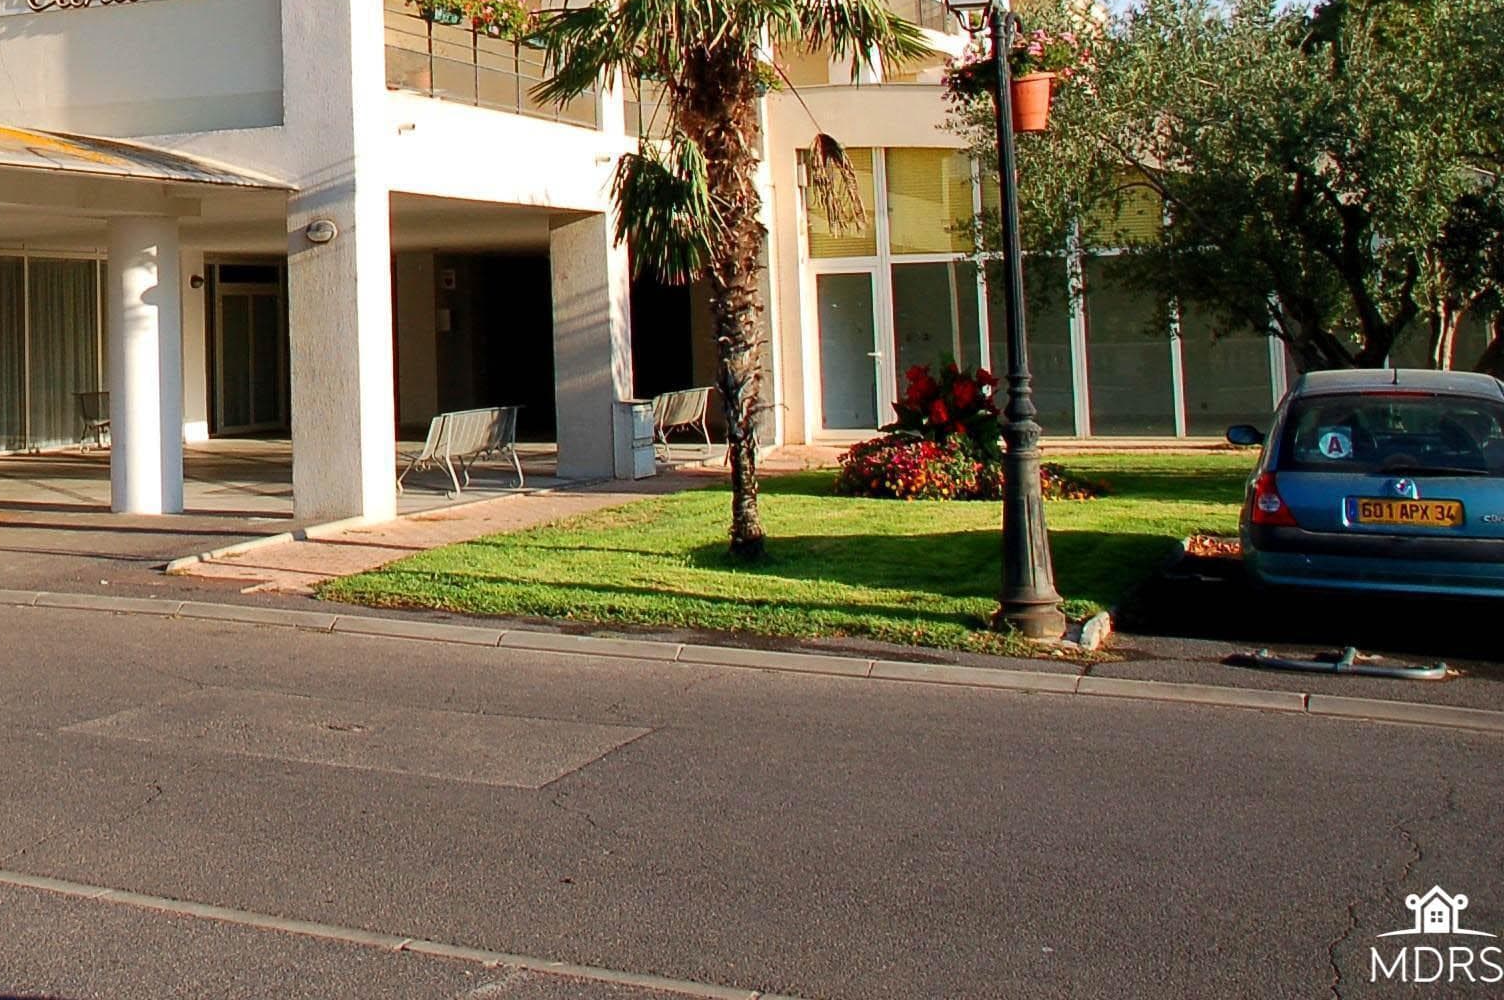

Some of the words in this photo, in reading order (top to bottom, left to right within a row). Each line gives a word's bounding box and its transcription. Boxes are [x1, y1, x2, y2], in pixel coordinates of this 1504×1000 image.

[1327, 435, 1344, 454] A
[1362, 503, 1394, 519] 601
[1399, 503, 1430, 521] APX
[1435, 505, 1456, 521] 34
